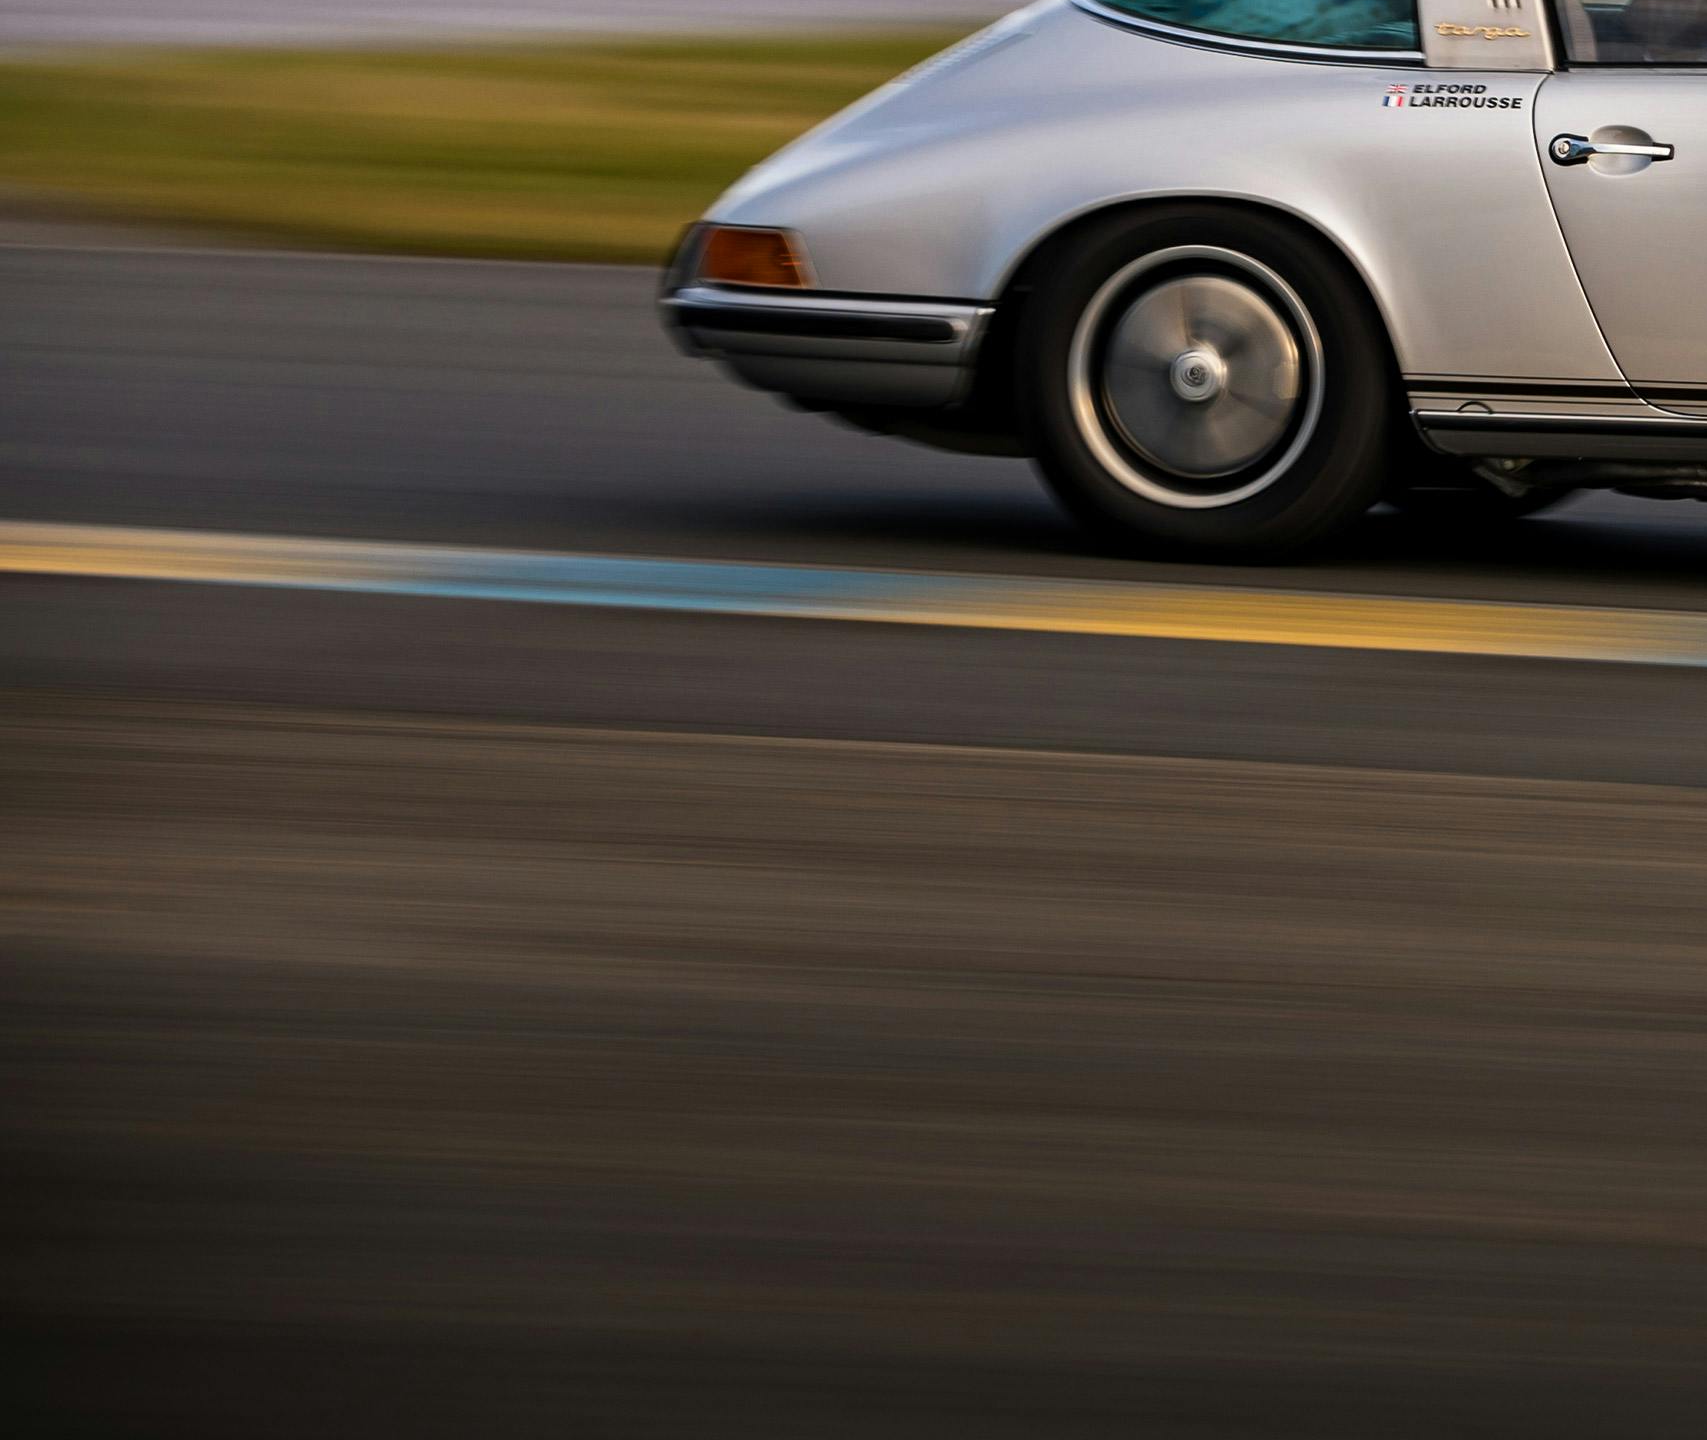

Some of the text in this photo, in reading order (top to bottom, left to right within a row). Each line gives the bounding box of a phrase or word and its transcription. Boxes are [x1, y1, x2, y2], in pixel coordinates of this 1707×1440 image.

[1434, 23, 1531, 41] targa
[1412, 84, 1487, 94] ELFORD
[1408, 95, 1523, 109] LARROUSSE
